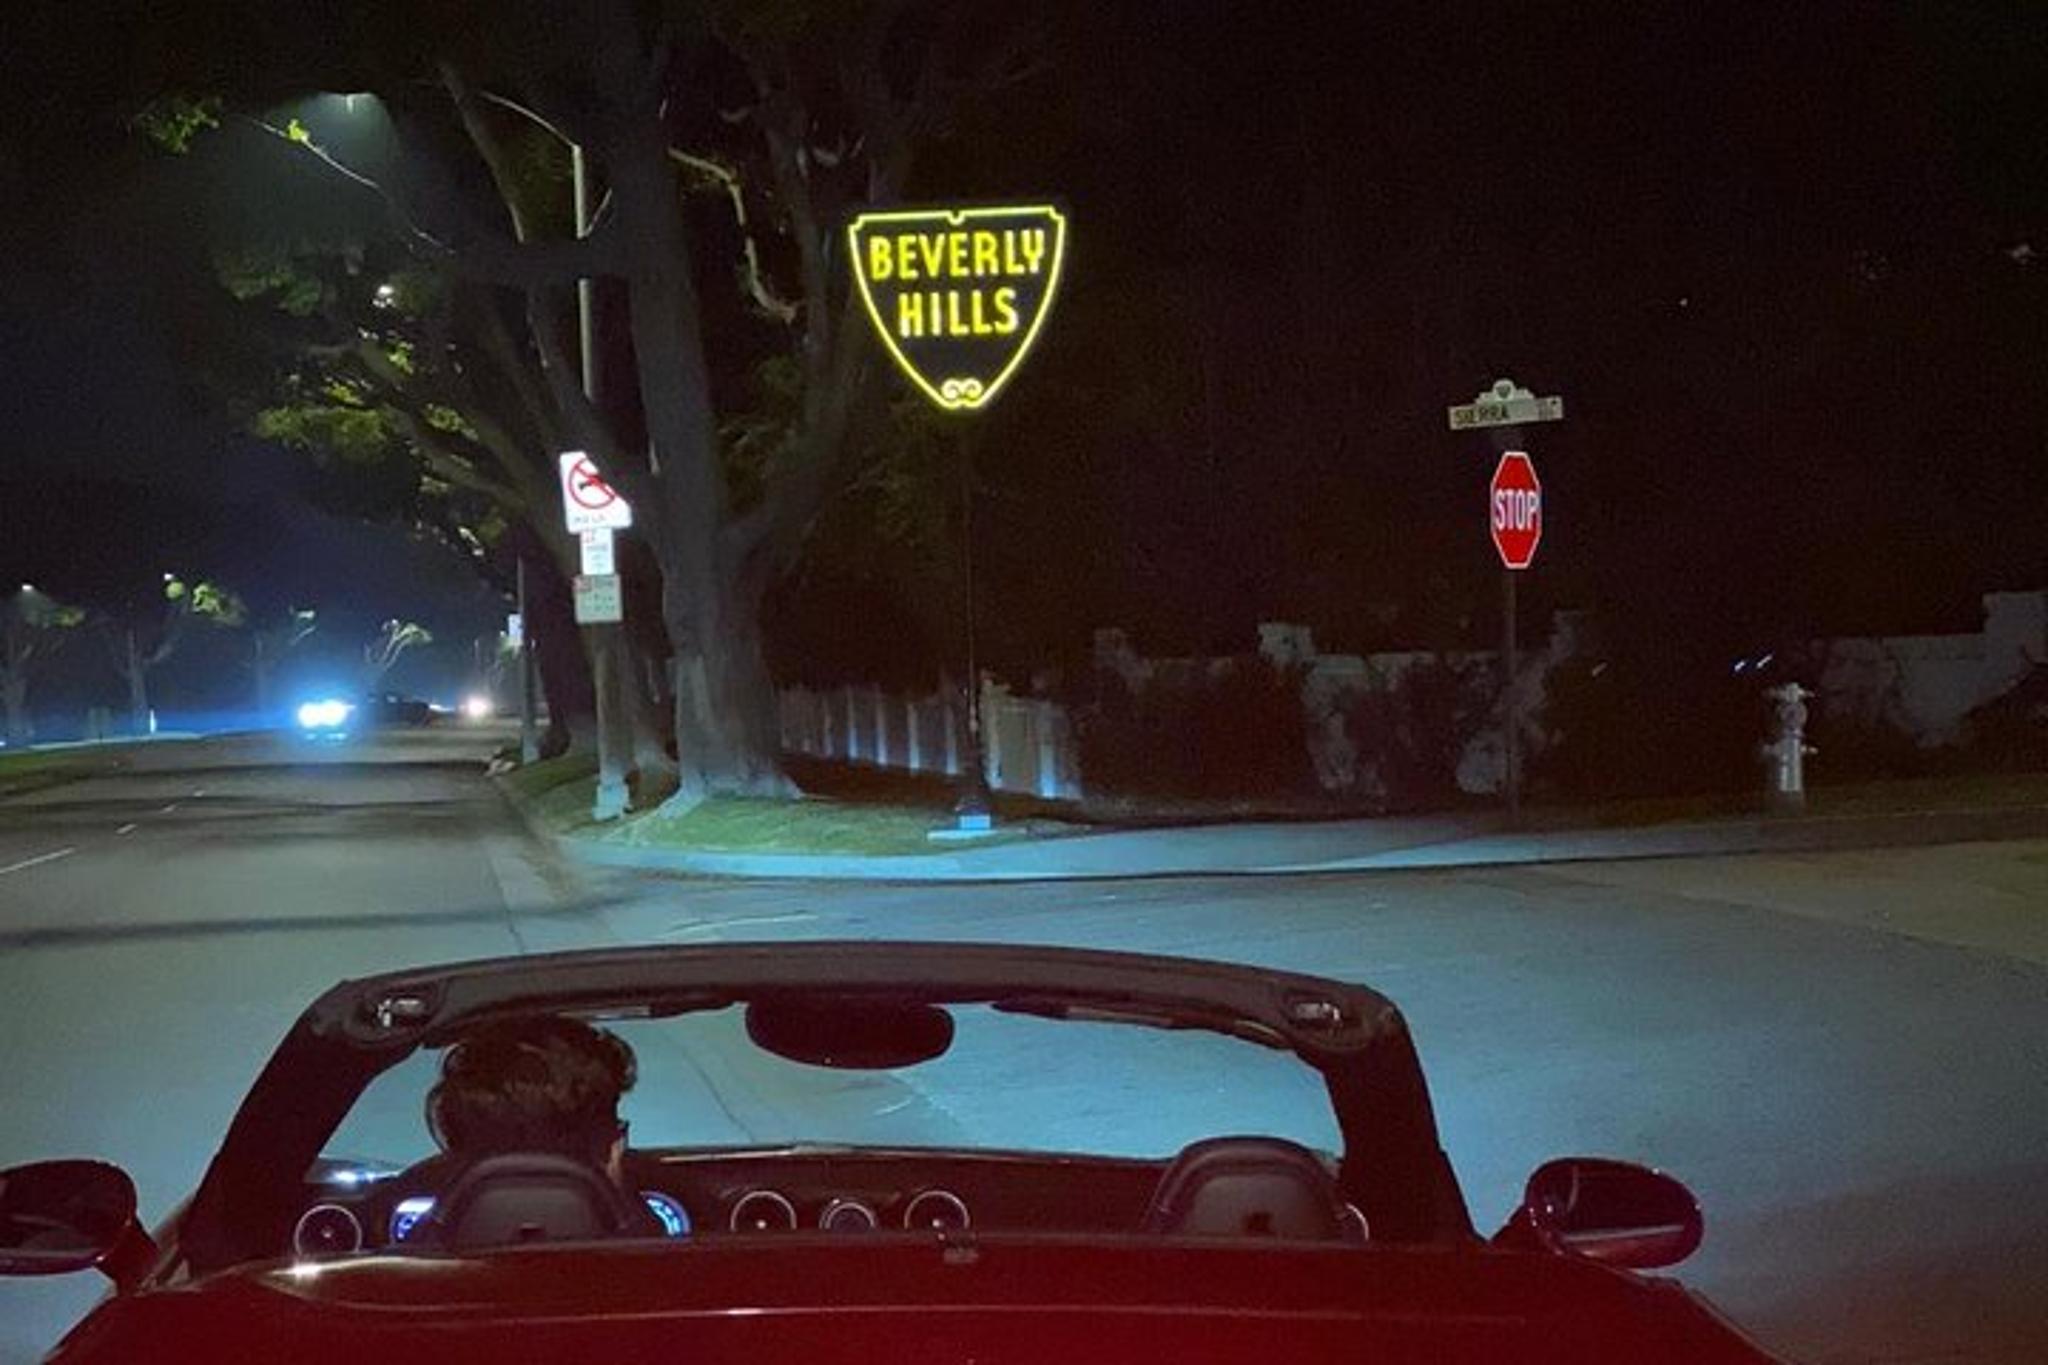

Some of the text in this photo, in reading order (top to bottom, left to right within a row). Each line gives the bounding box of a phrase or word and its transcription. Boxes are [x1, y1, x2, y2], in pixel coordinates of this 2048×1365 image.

[869, 229, 1045, 281] BEVERLY
[898, 286, 1020, 337] HILLS
[1495, 487, 1540, 532] STOP
